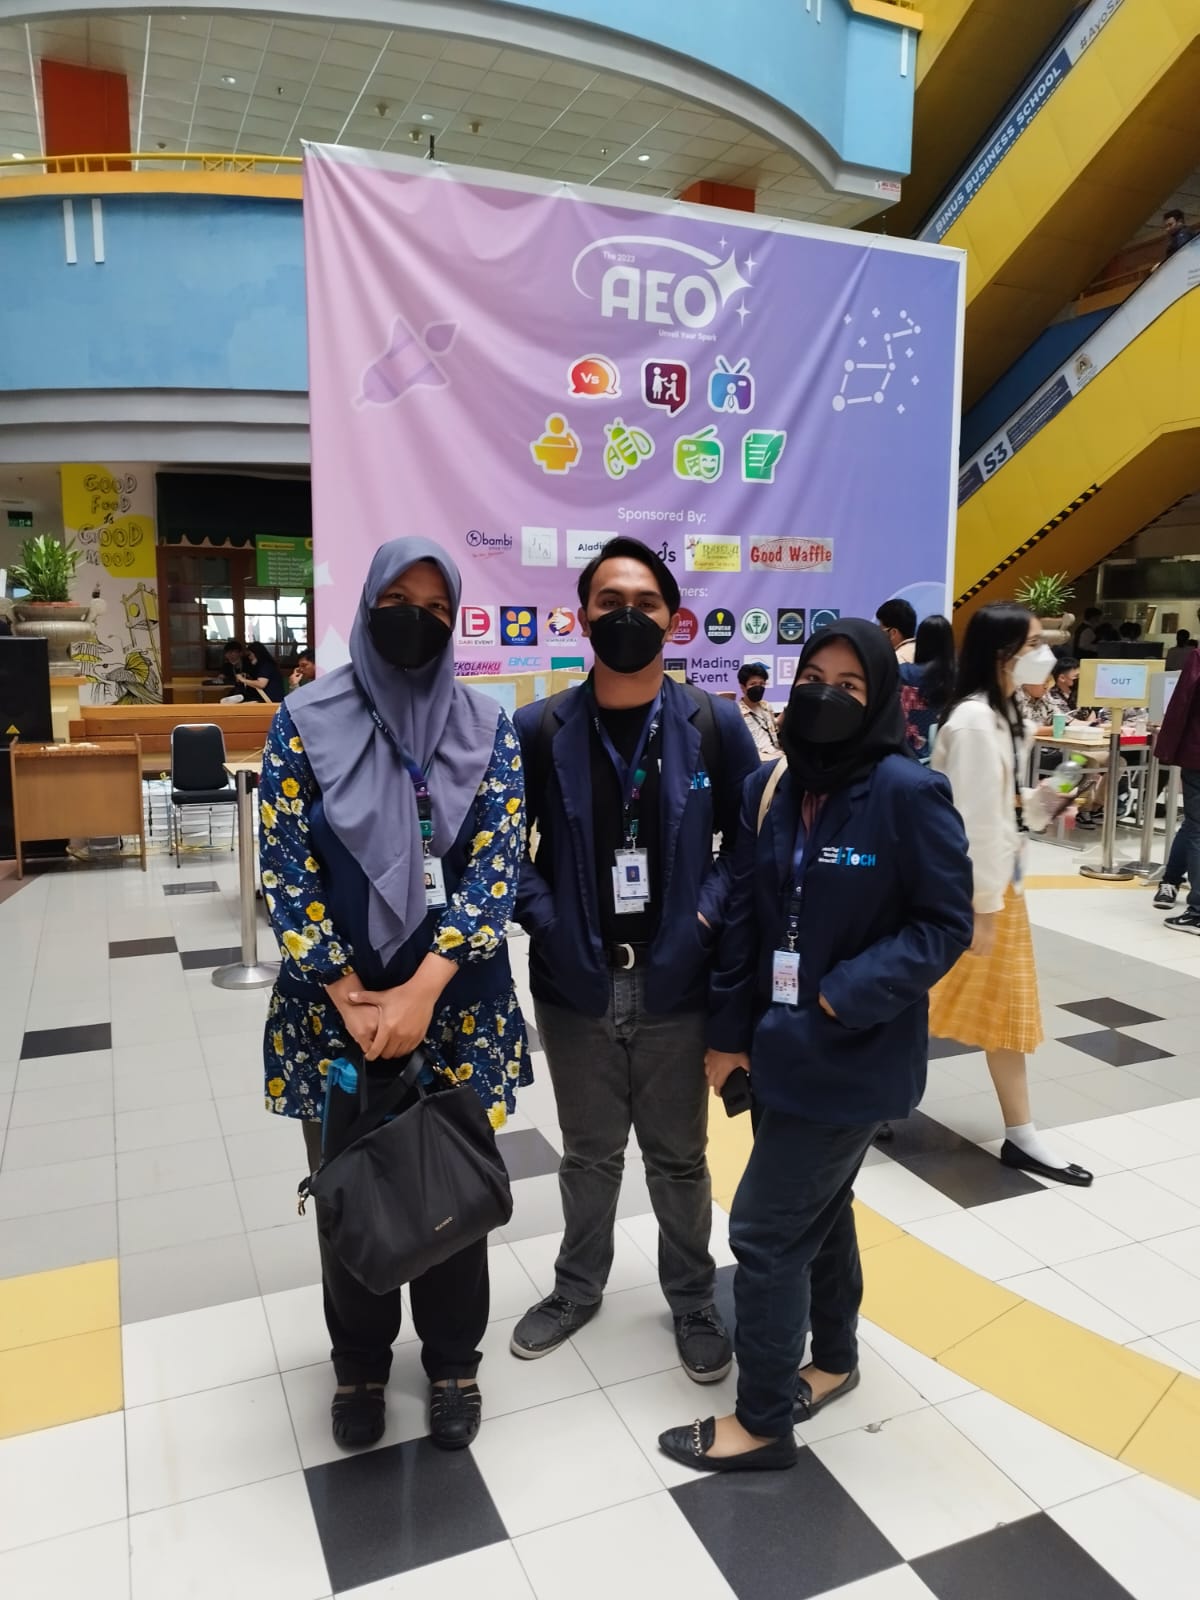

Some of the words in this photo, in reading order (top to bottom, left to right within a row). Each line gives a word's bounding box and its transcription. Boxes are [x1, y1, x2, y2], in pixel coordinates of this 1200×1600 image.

[935, 193, 965, 233] BINUS
[964, 124, 1015, 194] BUSINESS
[1016, 67, 1062, 126] SCHOOL
[601, 265, 717, 329] AEO
[580, 372, 600, 385] Vs
[983, 440, 1008, 475] S3
[84, 473, 137, 494] GOOD
[617, 507, 684, 522] Sponsored
[687, 510, 706, 525] By:
[78, 522, 143, 547] GOOD
[482, 532, 512, 547] bambi
[750, 545, 782, 563] Good
[789, 544, 832, 562] Waffle
[678, 585, 709, 597] ners:
[453, 661, 501, 671] EKOLAHKU
[691, 657, 740, 671] Mading
[691, 672, 728, 683] Event
[1110, 677, 1132, 685] OUT
